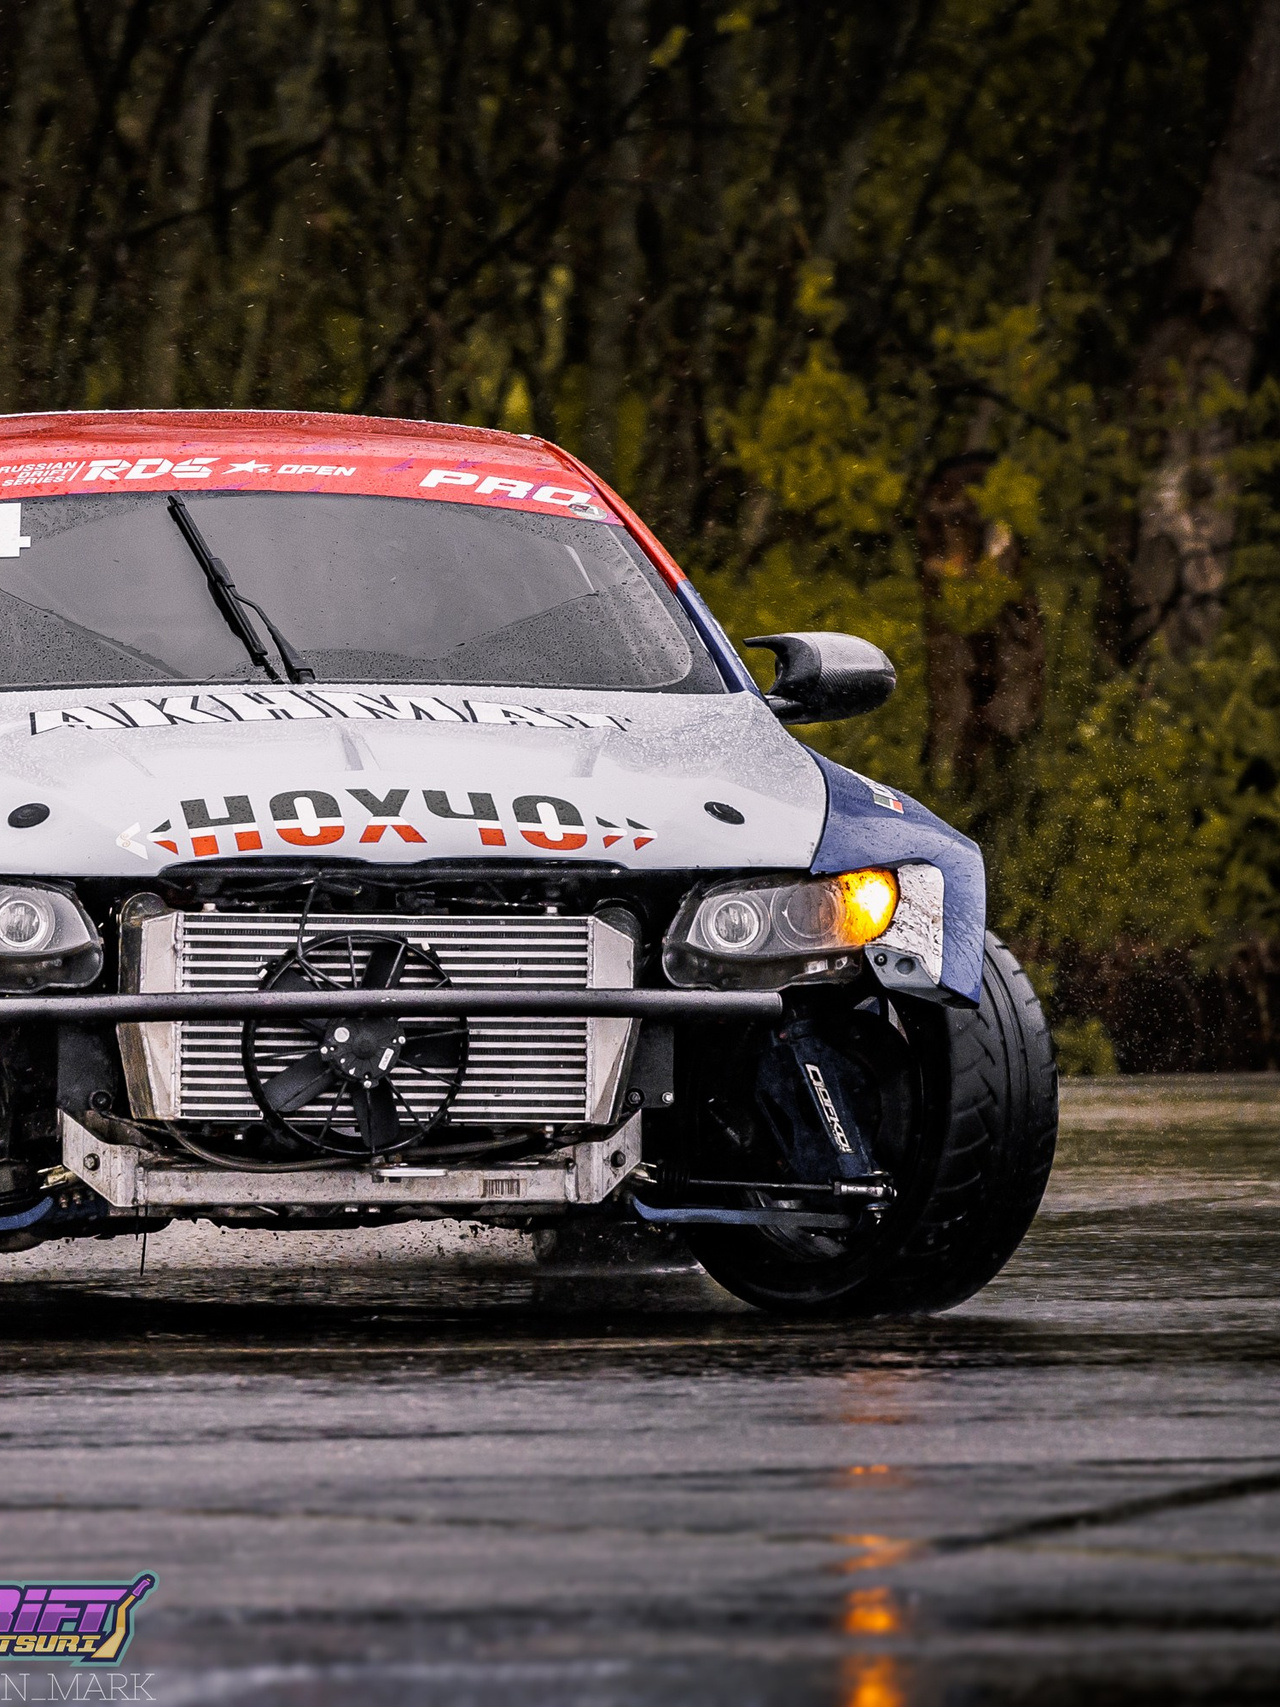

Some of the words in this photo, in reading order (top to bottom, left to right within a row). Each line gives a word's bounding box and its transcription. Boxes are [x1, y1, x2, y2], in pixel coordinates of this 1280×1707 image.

[1, 475, 66, 487] SERIES
[17, 468, 72, 479] DRIFT
[82, 457, 221, 482] RDS
[276, 464, 357, 477] OPEN
[419, 469, 592, 506] PRO
[29, 690, 632, 733] AKHMAT
